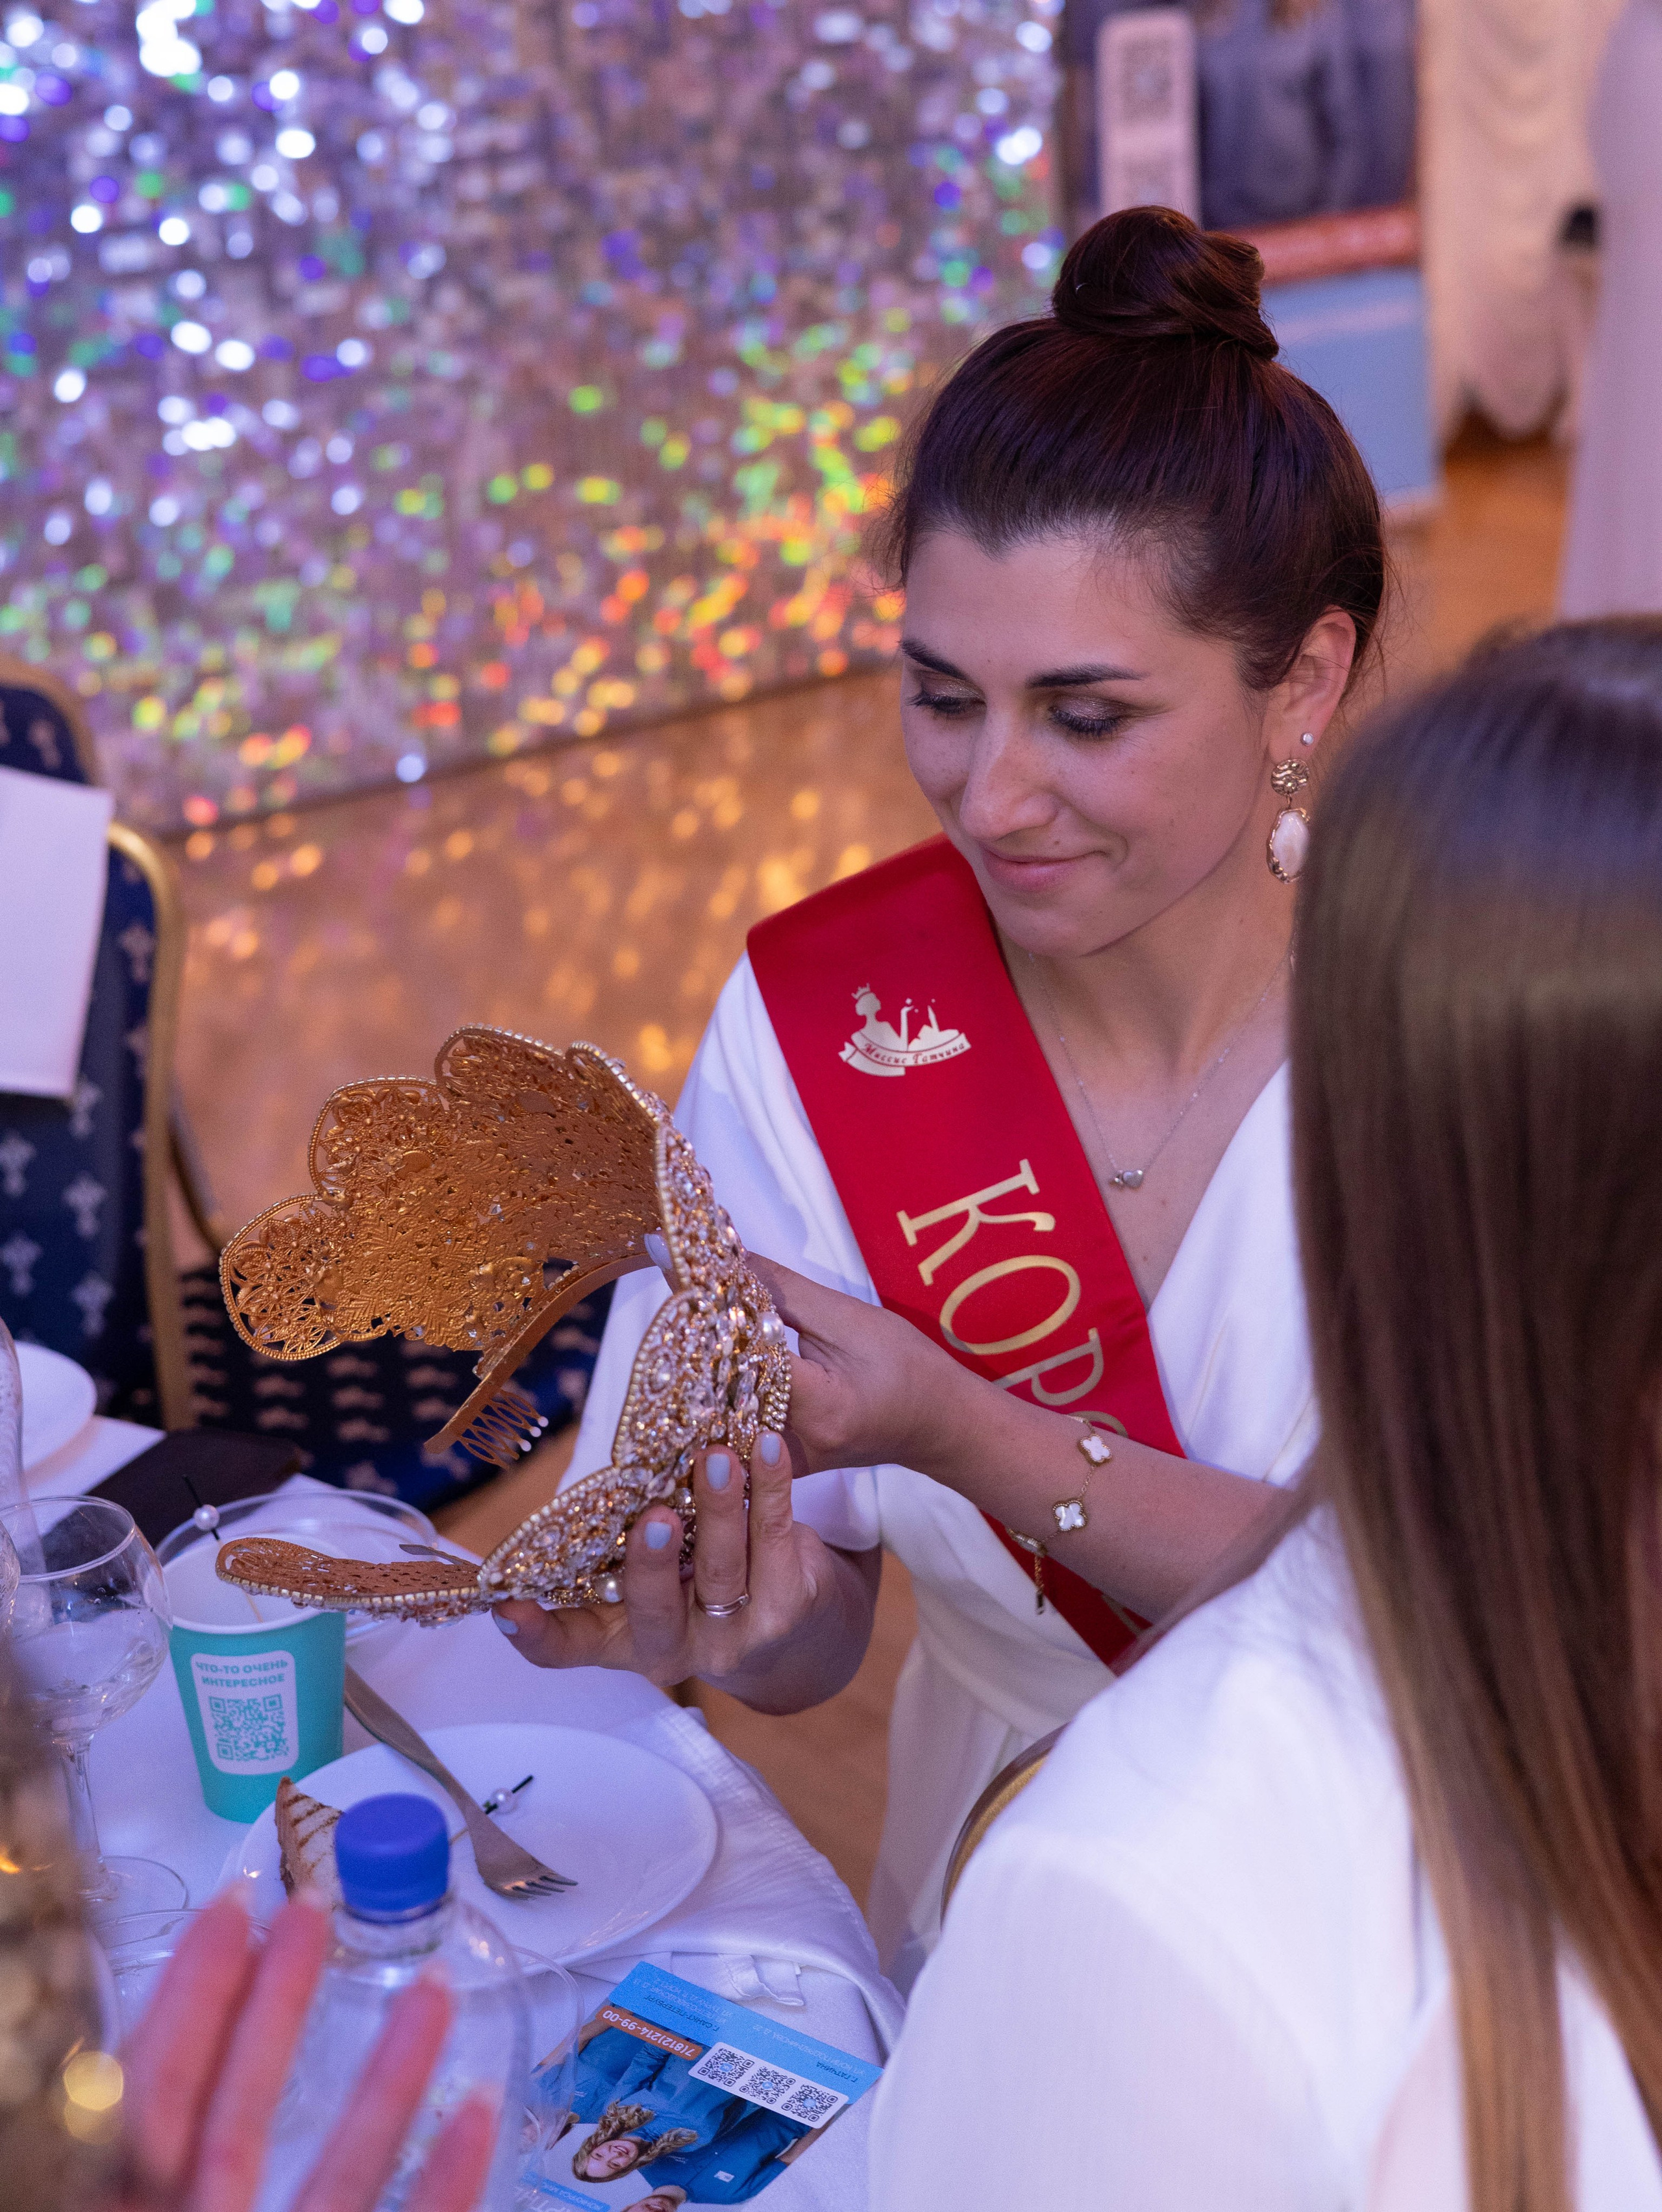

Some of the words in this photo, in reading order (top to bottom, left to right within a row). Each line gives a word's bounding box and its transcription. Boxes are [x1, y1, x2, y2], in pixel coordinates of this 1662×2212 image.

[863, 1043, 908, 1064] Миссис
[912, 1042, 965, 1064] Гатчина
[196, 1662, 240, 1674] ЧТО-ТО
[243, 1660, 288, 1673] ОЧЕНЬ
[202, 1673, 284, 1687] ИНТЕРЕСНОЕ
[643, 1994, 713, 2028] САНКТ-ПЕТЕРБУРГ
[602, 2009, 695, 2056] 7(812)214-99-00
[815, 2061, 850, 2079] ГАТЧИНА
